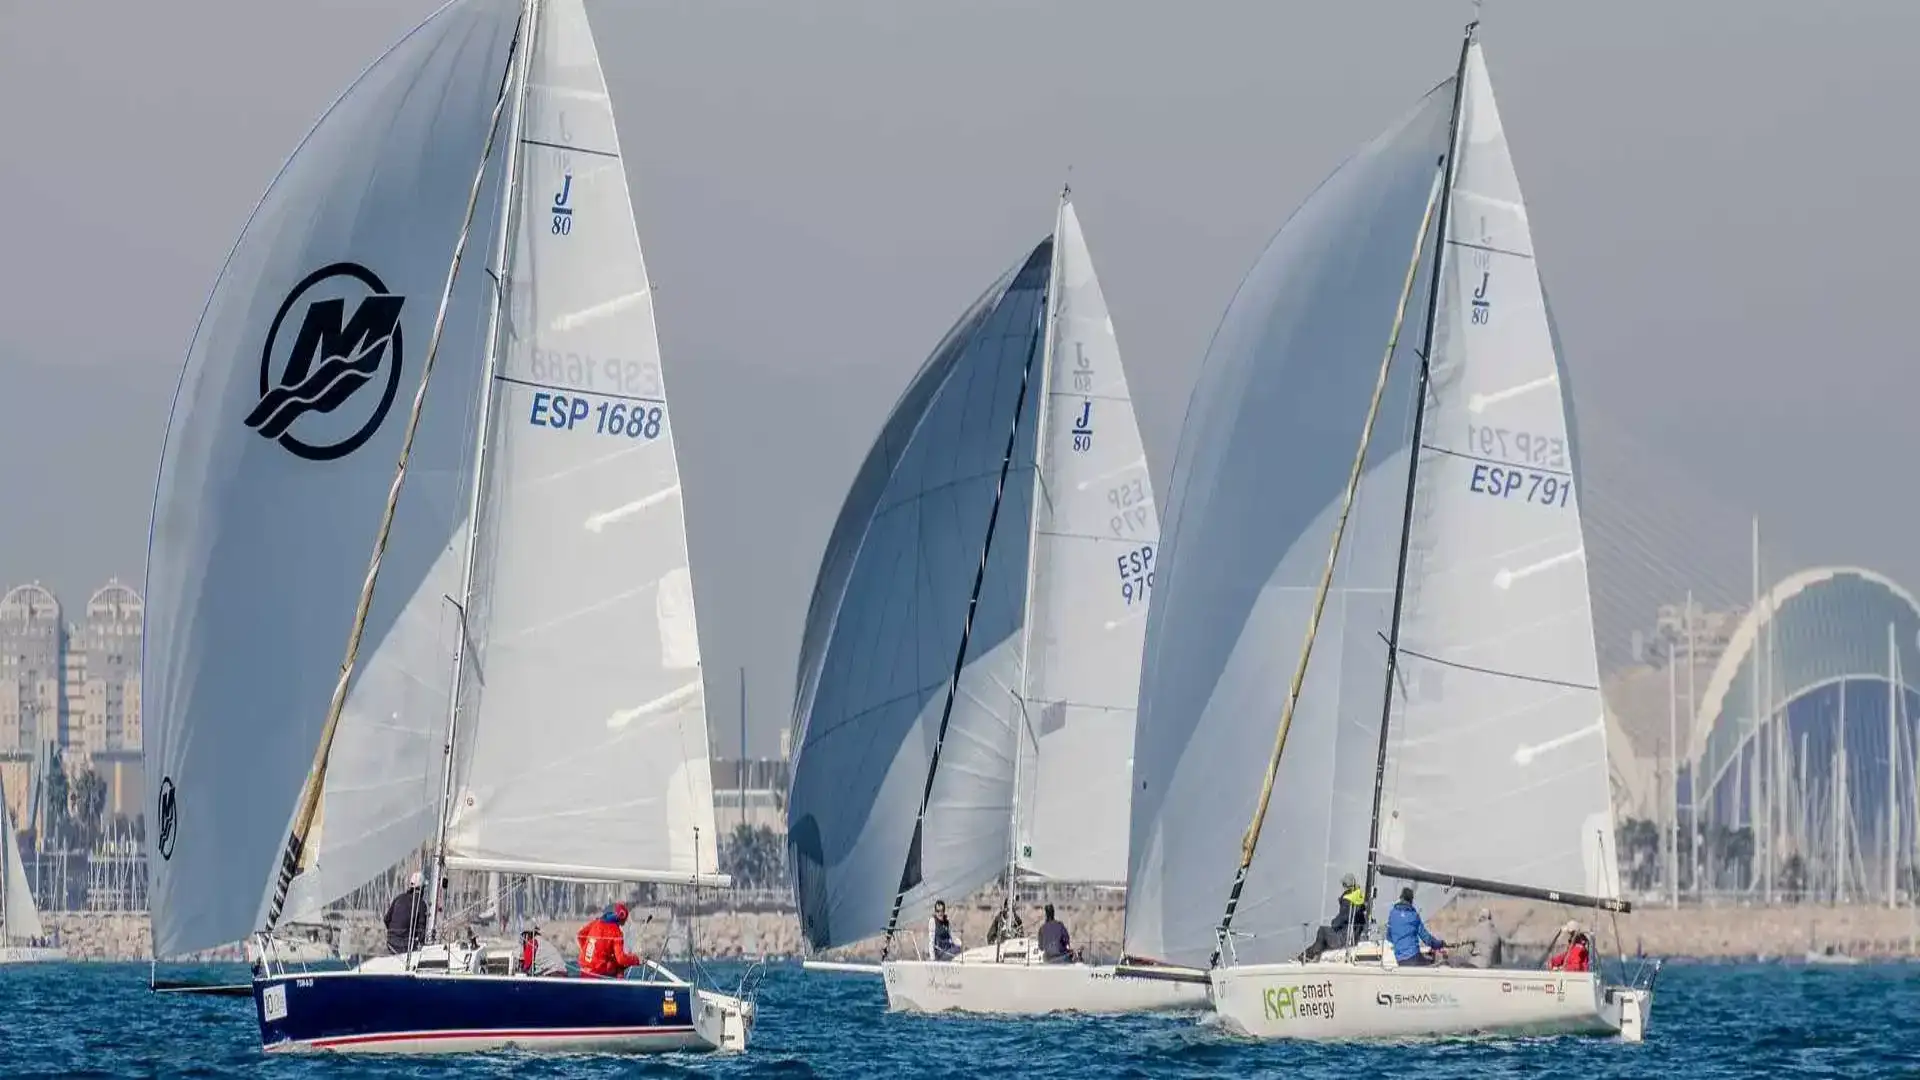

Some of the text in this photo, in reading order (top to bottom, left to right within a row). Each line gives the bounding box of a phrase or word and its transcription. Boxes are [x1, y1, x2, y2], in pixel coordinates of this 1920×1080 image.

[555, 174, 572, 206] J
[551, 216, 571, 236] 80
[1474, 272, 1490, 299] J
[1471, 308, 1489, 325] 80
[529, 392, 662, 439] ESP 1688
[1075, 402, 1091, 428] J
[1073, 436, 1091, 452] 80
[1470, 464, 1571, 508] ESP 791
[1117, 546, 1153, 580] ESP
[1302, 980, 1334, 999] smart
[1300, 1001, 1335, 1019] energy
